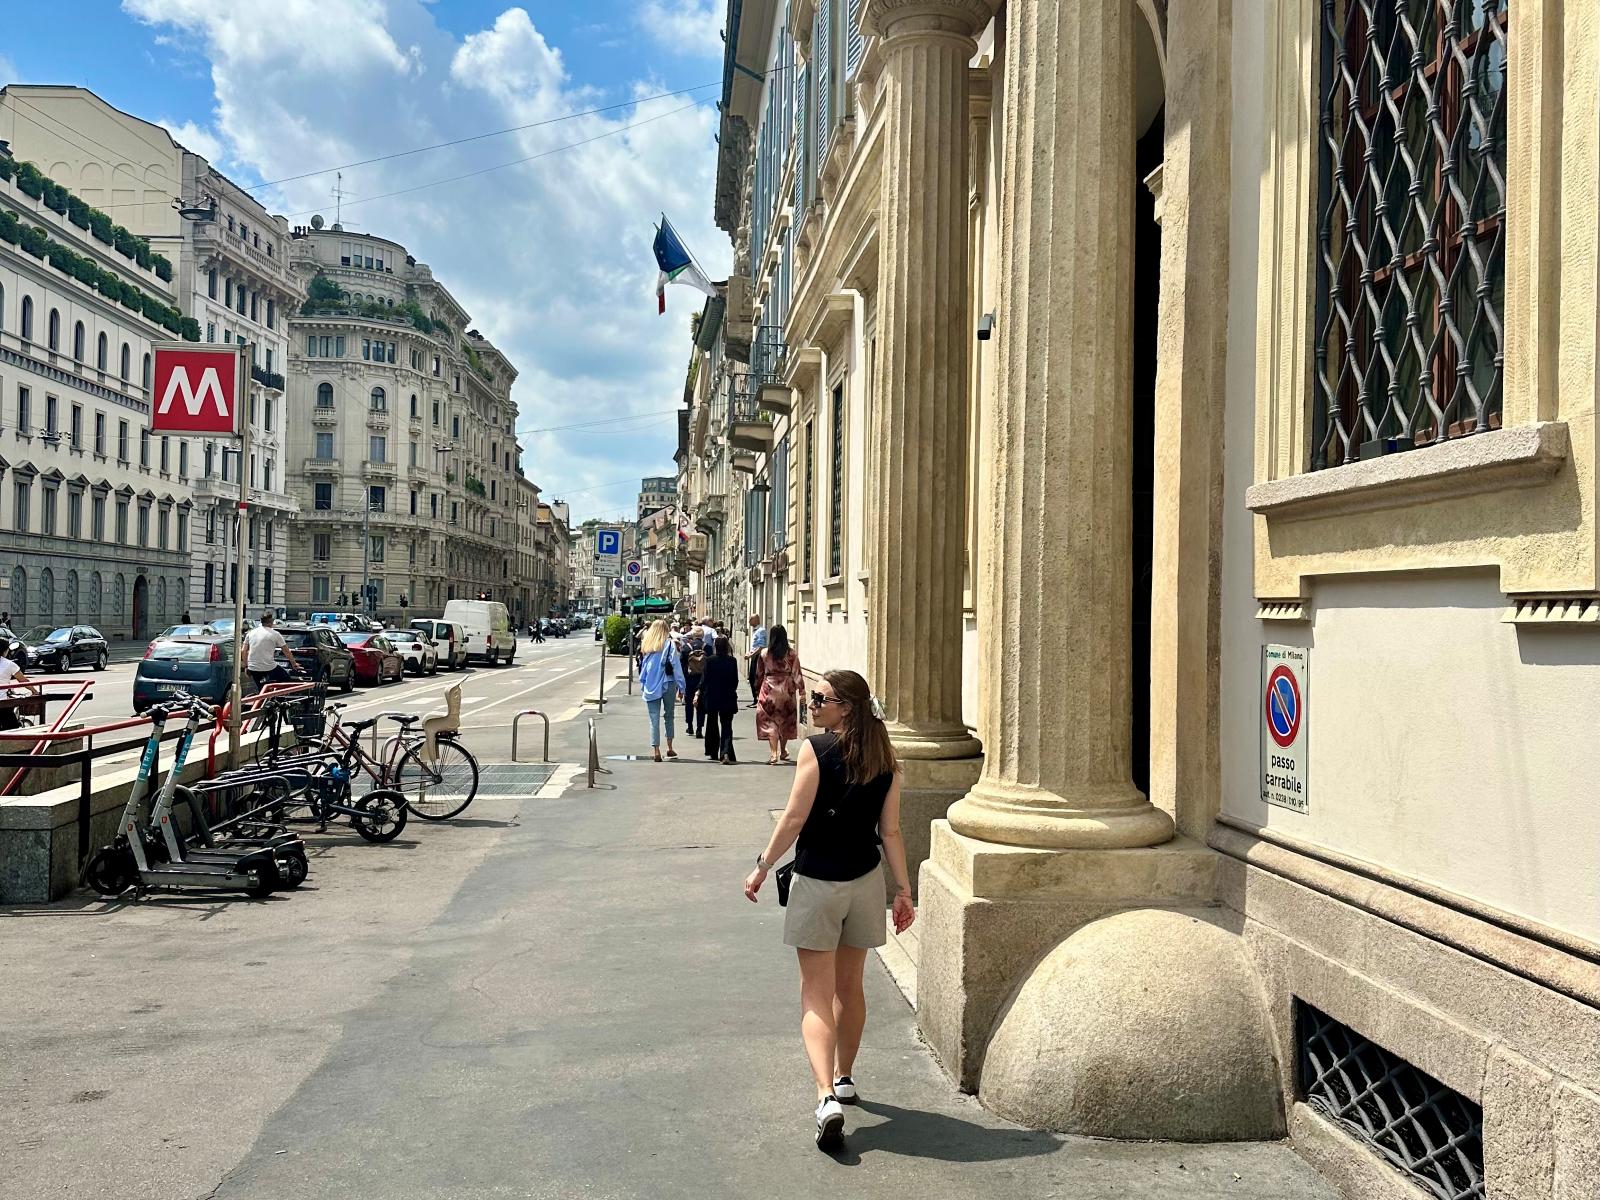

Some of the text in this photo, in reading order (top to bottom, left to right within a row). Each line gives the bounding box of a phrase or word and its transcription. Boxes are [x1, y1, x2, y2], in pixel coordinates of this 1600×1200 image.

[157, 365, 229, 417] M
[602, 534, 615, 551] P
[1265, 649, 1303, 660] Comune di Milano
[1271, 754, 1295, 771] passo
[1265, 773, 1302, 794] carrabile
